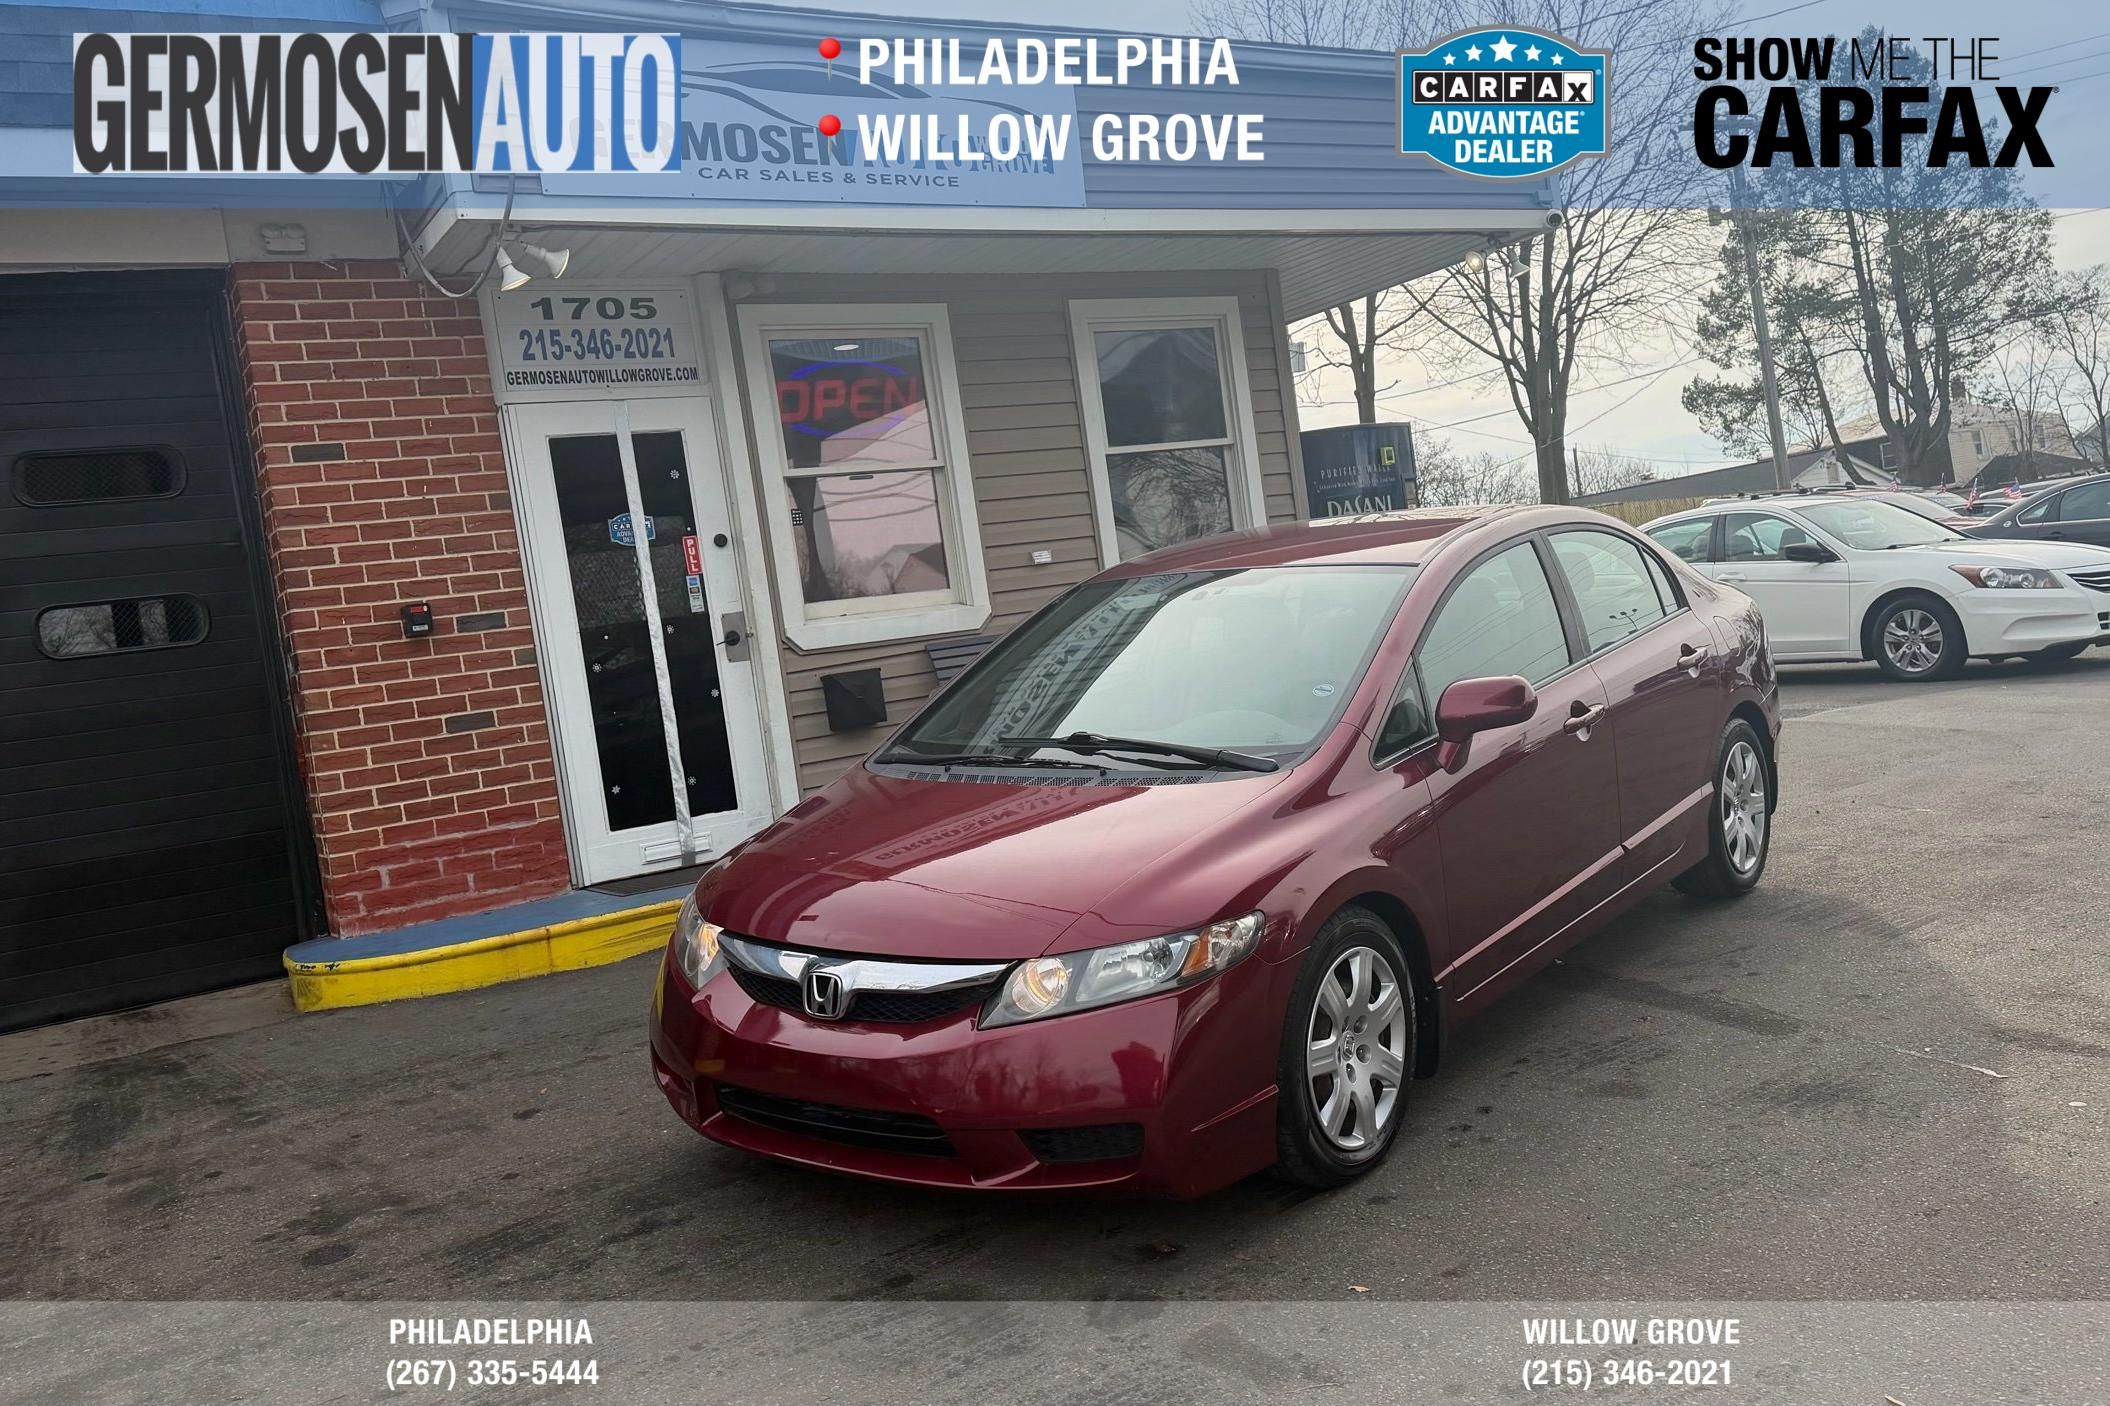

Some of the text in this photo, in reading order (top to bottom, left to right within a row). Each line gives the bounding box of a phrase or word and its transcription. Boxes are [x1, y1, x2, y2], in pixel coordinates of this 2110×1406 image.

[698, 167, 960, 187] CAR SALES & SERVICE
[530, 296, 658, 321] 1705
[519, 327, 676, 361] 215-346-2021
[506, 366, 700, 386] GERMOSENAUTOWILLOWGROVE.COM
[777, 376, 922, 424] OPEN
[1327, 495, 1393, 517] DASANI
[686, 538, 699, 572] PULL
